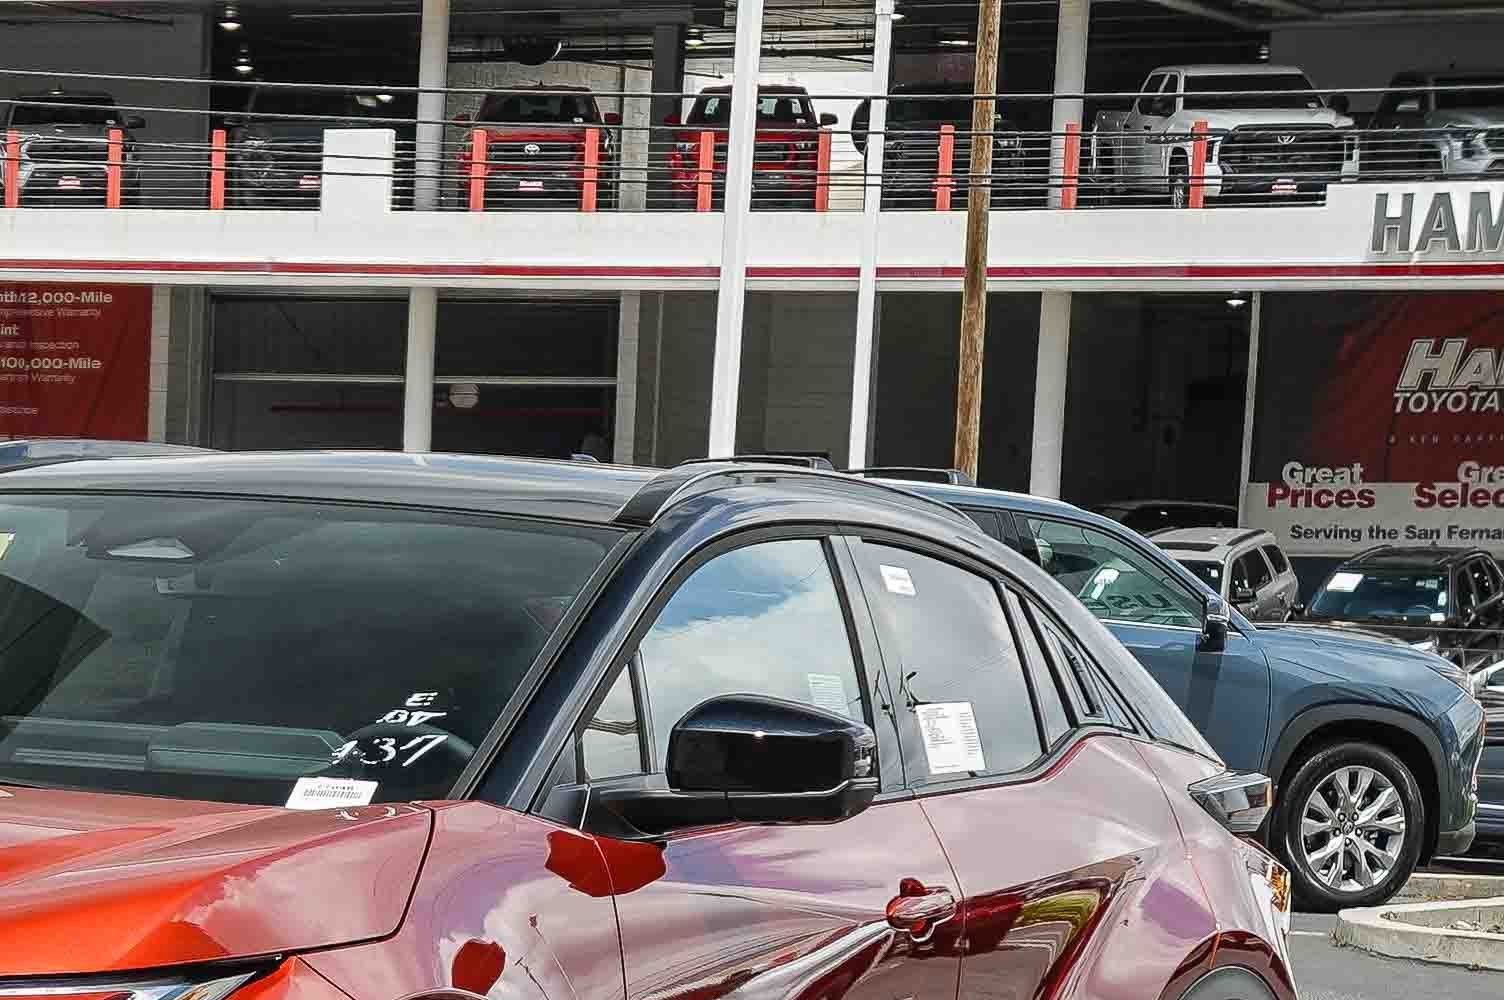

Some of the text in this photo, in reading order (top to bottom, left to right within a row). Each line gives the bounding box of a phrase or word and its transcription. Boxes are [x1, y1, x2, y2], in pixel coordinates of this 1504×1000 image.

[1393, 391, 1500, 413] TOYOTA
[1282, 461, 1364, 485] Great
[1266, 482, 1377, 509] Prices
[1290, 525, 1363, 542] Serving
[1368, 525, 1399, 540] the
[1405, 525, 1441, 540] San
